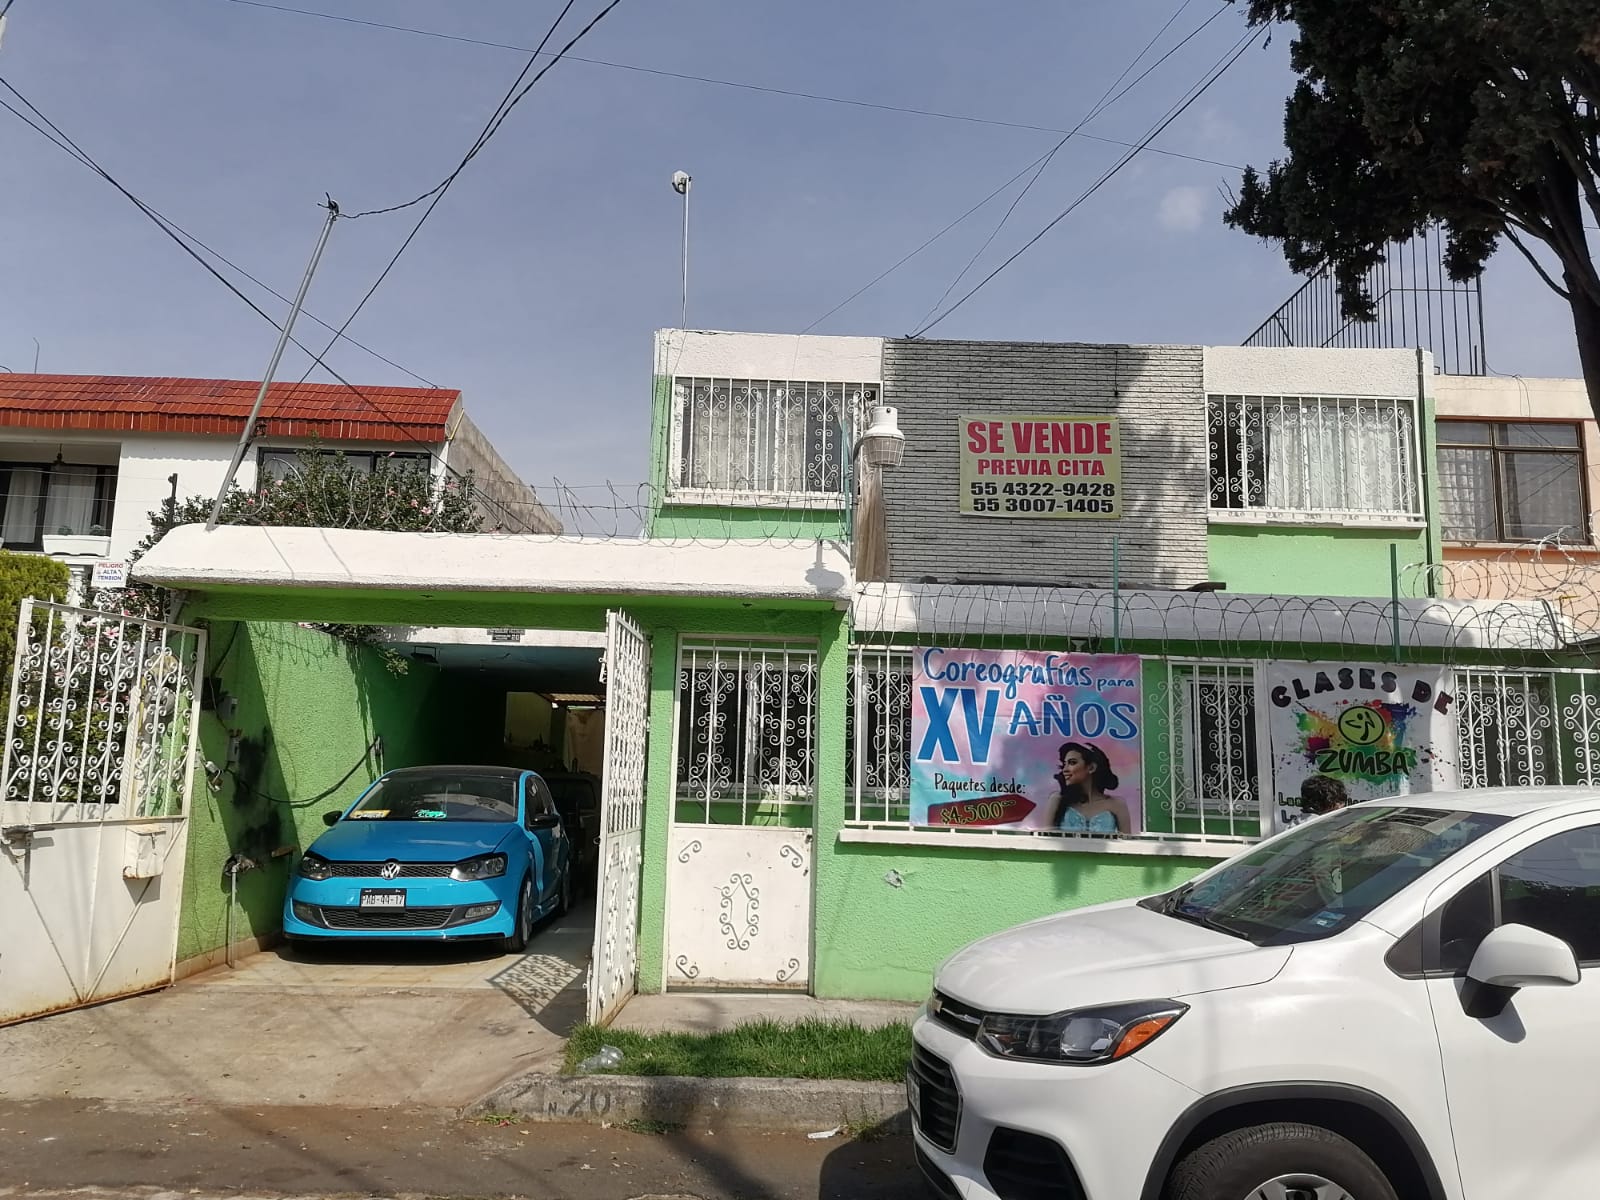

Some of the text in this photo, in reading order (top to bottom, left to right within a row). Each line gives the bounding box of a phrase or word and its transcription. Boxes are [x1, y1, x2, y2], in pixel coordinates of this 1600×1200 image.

[967, 421, 1113, 454] SE VENDE
[977, 459, 1105, 476] PREVIA CITA
[970, 482, 1115, 497] 55 4322-9428
[973, 498, 1113, 513] 55 3007-1405
[923, 648, 1134, 699] Coreografías para
[1271, 667, 1454, 716] CLASES DE
[917, 686, 1139, 764] XV AÑOS
[1316, 749, 1410, 776] ZUMBA
[935, 772, 1026, 798] Paquetes desde:
